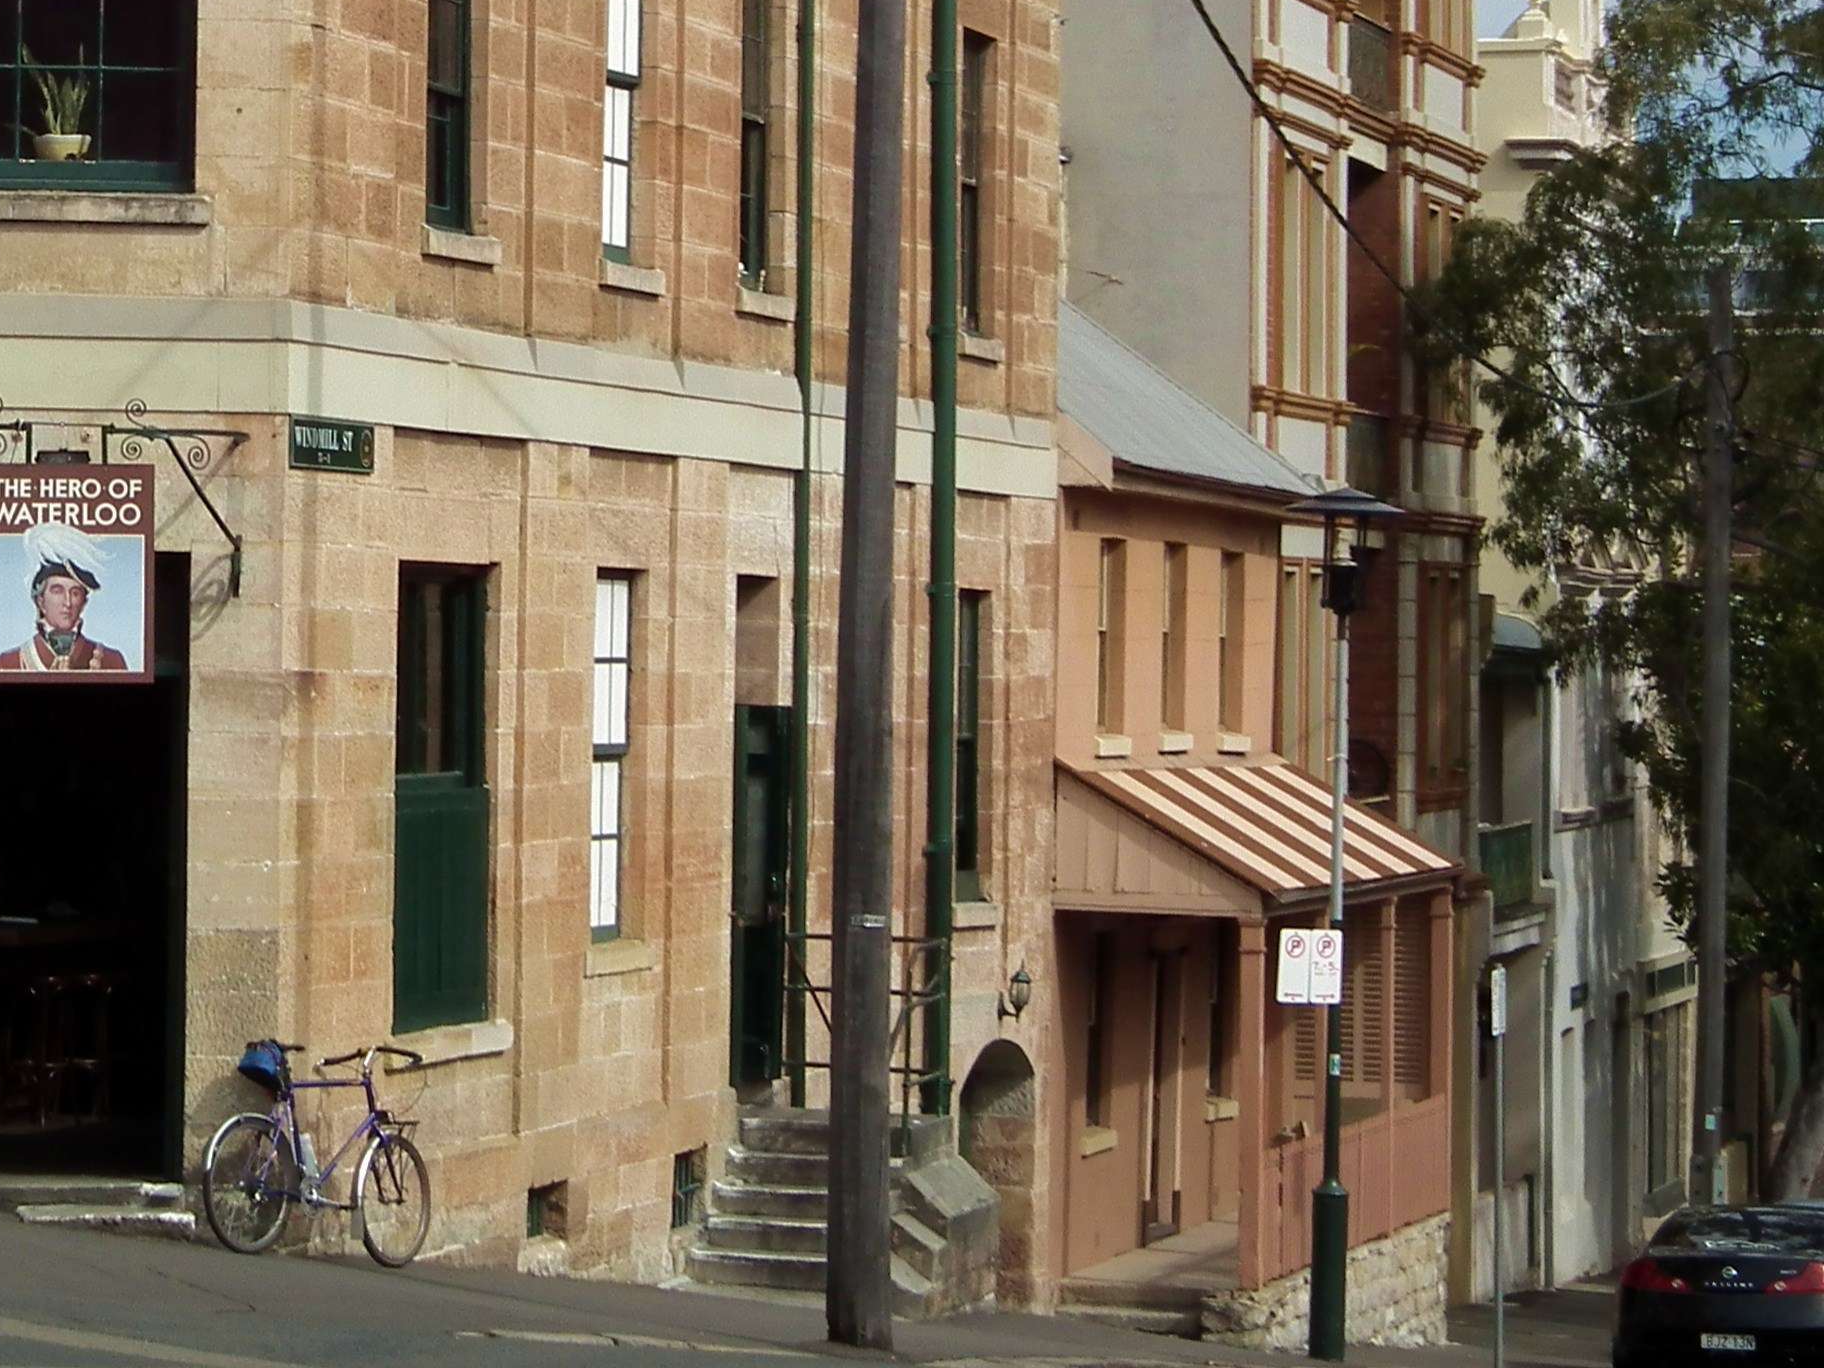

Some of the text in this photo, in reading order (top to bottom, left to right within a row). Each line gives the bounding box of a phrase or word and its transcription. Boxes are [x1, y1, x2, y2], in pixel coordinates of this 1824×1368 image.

[294, 426, 353, 452] WINDMILL ST
[39, 478, 102, 499] HERO
[107, 478, 143, 499] OF
